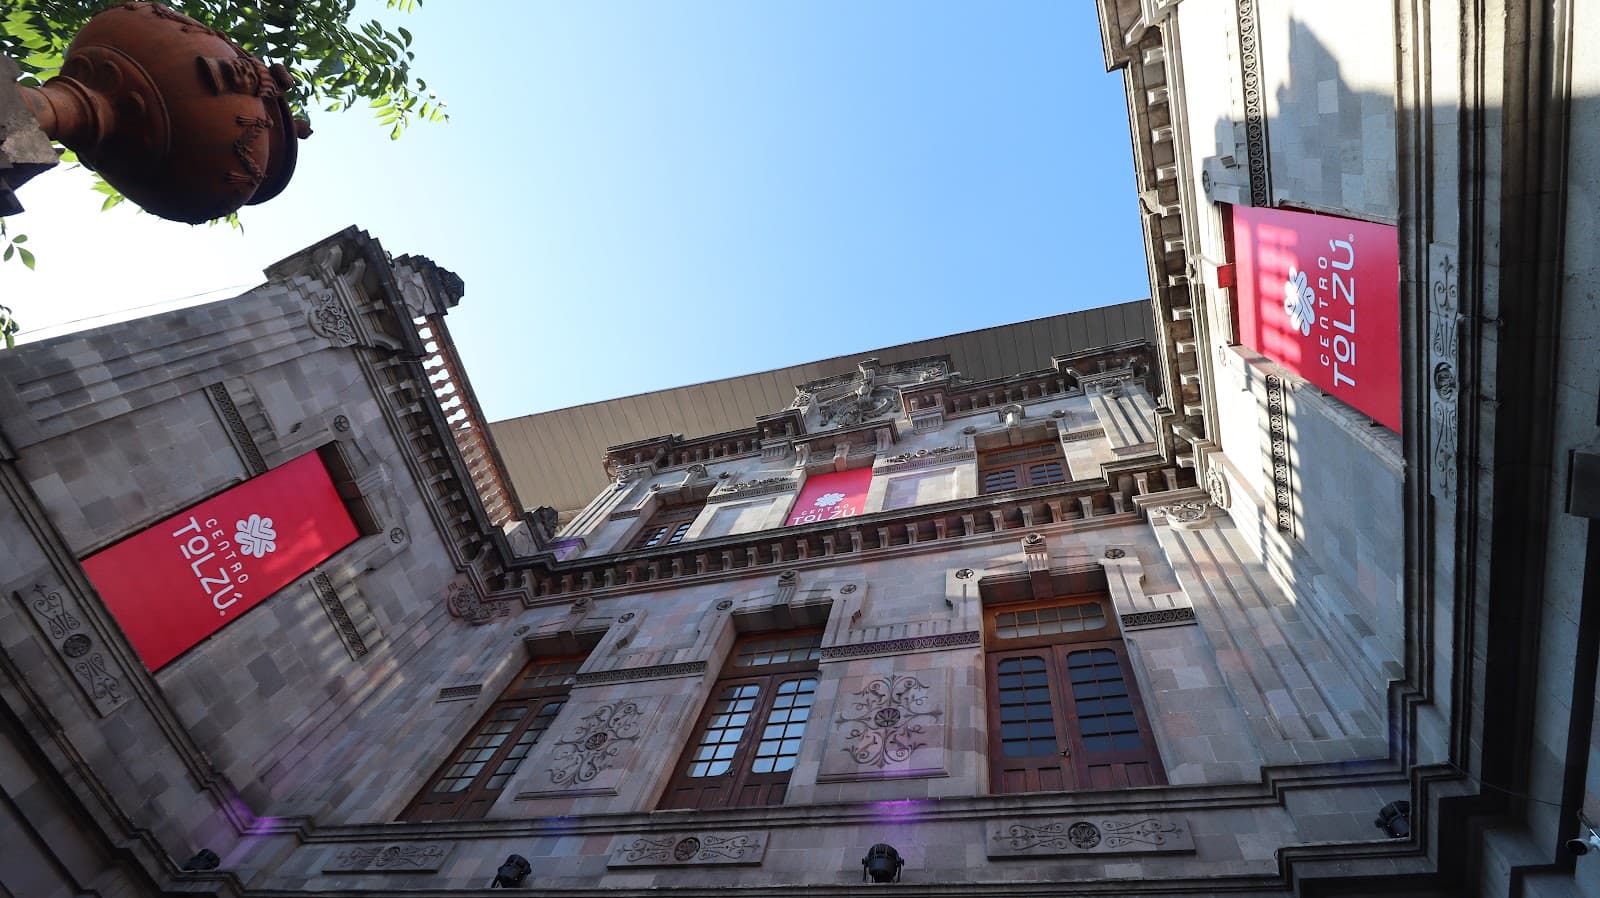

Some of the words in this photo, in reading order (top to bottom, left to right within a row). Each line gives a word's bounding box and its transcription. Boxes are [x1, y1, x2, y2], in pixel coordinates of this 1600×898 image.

[1318, 256, 1330, 367] CENTRO
[1329, 239, 1356, 387] TOLZÚ
[205, 518, 248, 584] CENTRO
[801, 503, 849, 516] CENTRO
[172, 516, 243, 610] TOLZÚ
